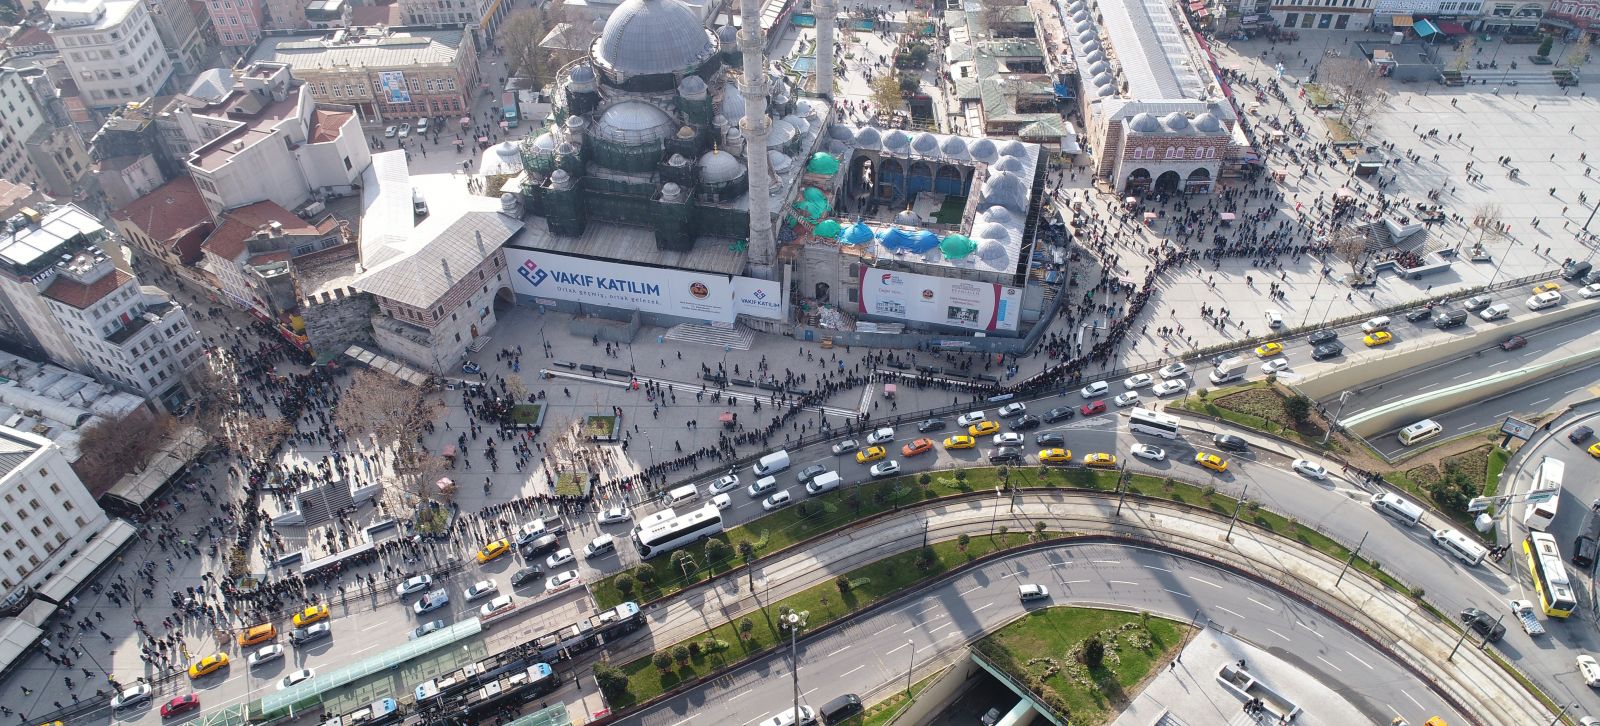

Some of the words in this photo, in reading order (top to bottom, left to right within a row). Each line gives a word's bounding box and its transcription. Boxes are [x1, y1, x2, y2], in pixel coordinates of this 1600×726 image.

[32, 267, 55, 285] ALPEK
[550, 270, 593, 287] VAKIF
[597, 277, 660, 296] KATILIM
